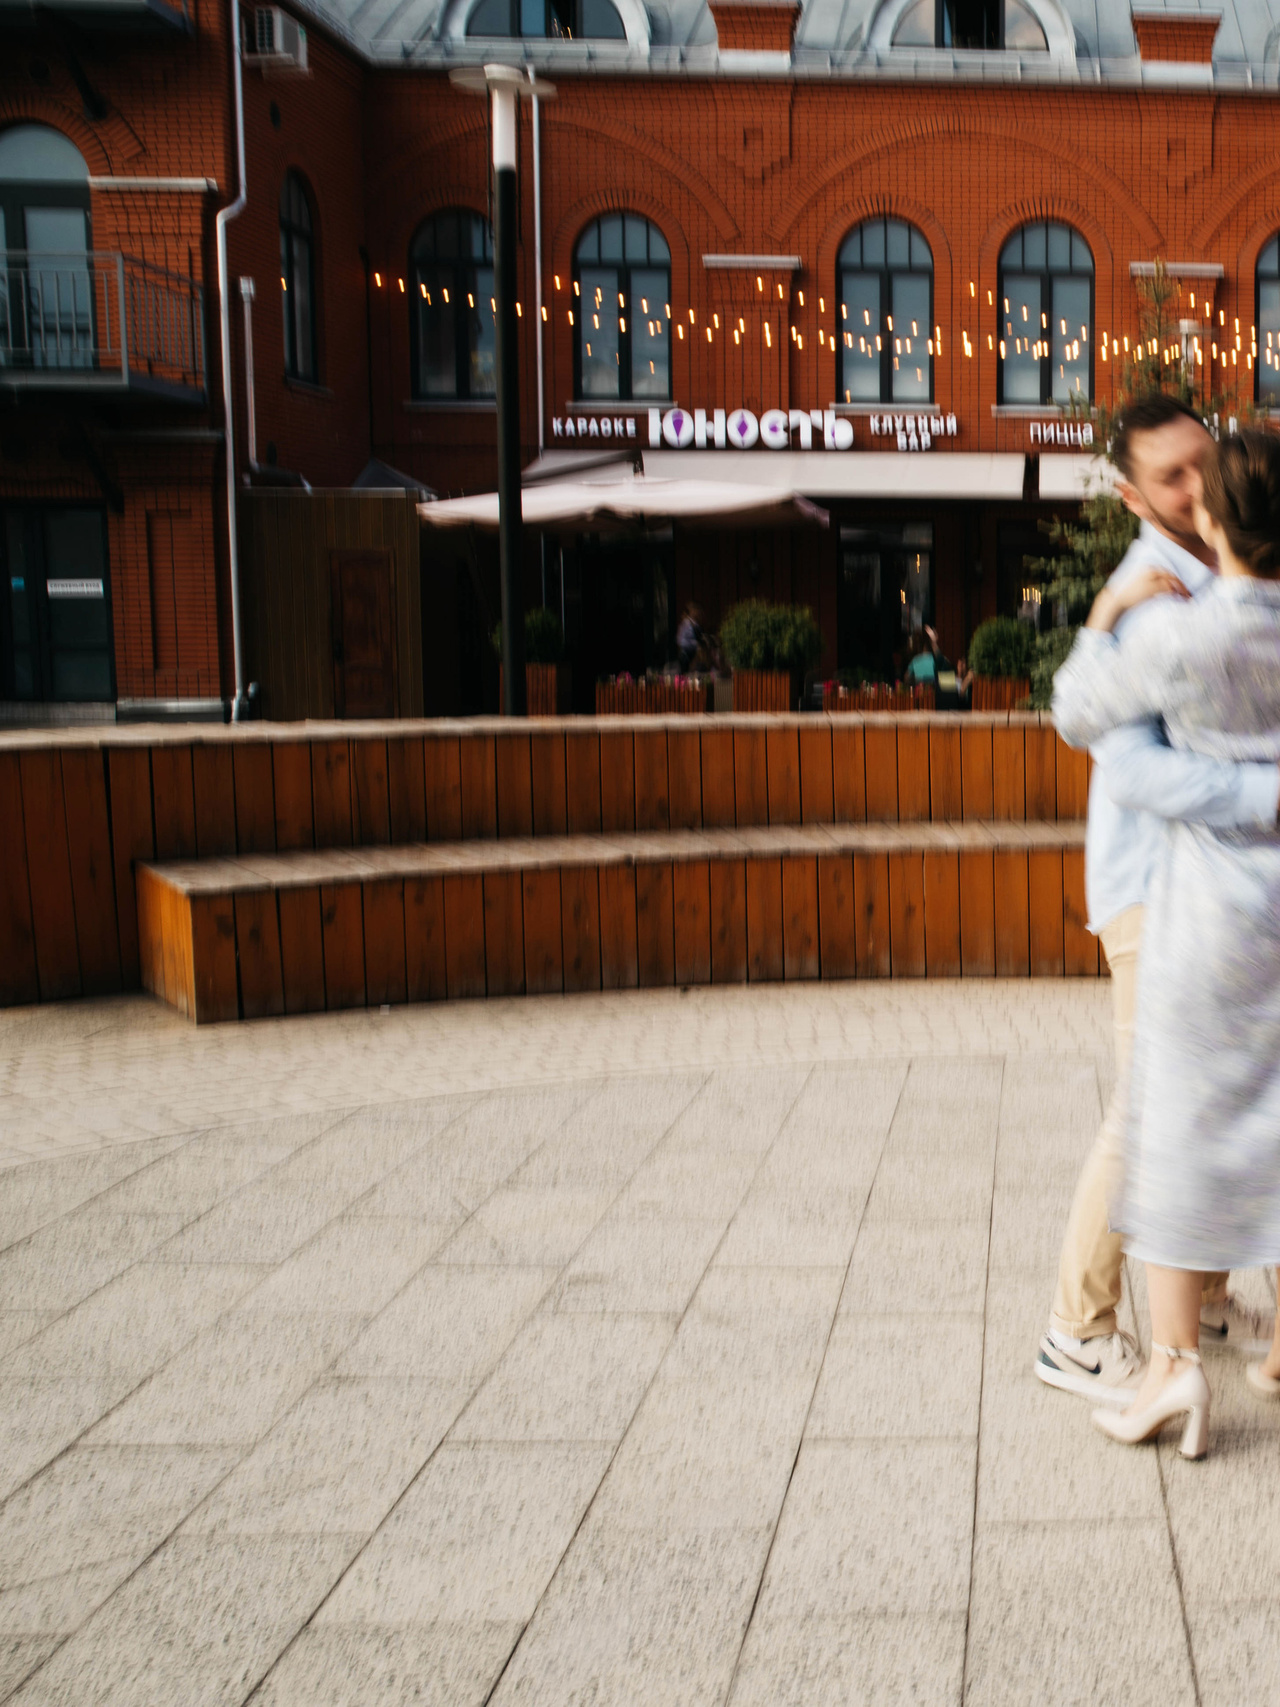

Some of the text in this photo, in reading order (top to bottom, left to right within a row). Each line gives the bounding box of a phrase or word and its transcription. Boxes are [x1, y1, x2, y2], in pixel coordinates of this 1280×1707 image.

[552, 417, 636, 437] КАРАОКЕ
[648, 408, 854, 450] ЮНОСТЬ
[870, 412, 957, 436] КЛУБНЫЙ
[897, 431, 931, 451] БАР
